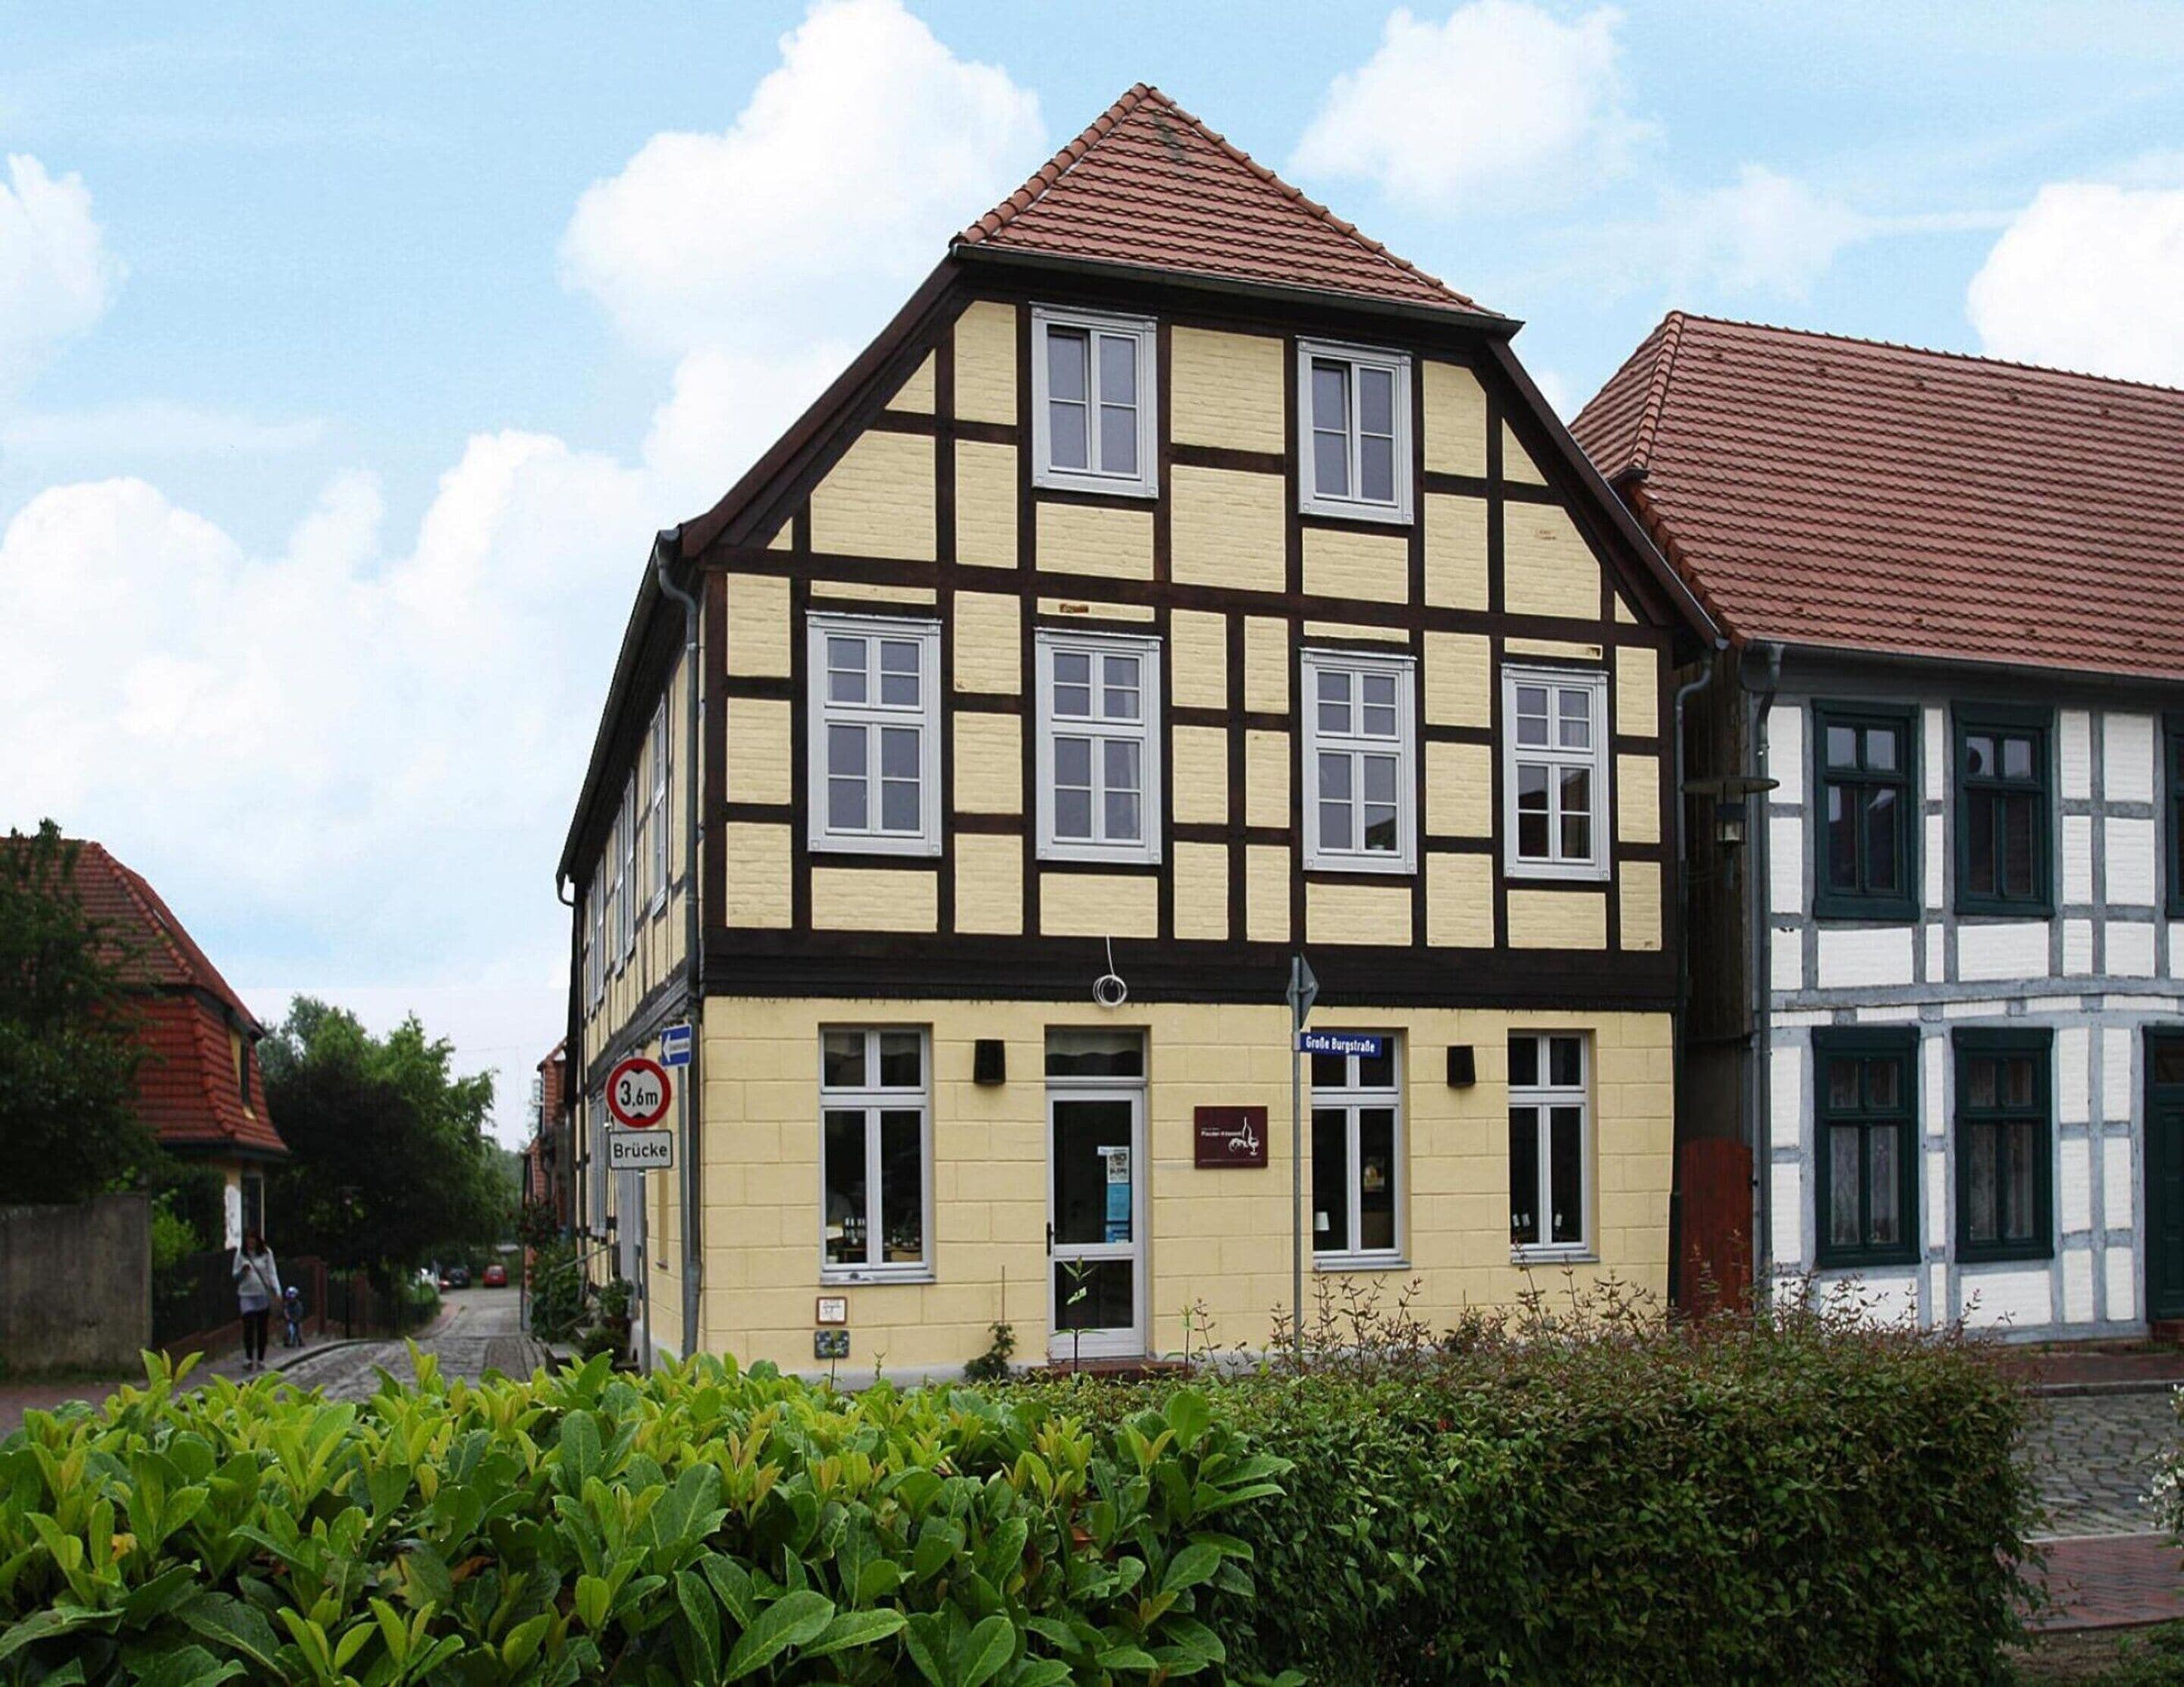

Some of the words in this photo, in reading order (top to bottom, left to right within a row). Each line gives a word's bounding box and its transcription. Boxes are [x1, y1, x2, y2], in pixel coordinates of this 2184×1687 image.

[1306, 1036, 1329, 1049] Große
[1332, 1037, 1375, 1053] Burgstraße
[620, 1080, 658, 1107] 3,6m
[613, 1143, 667, 1159] Brücke
